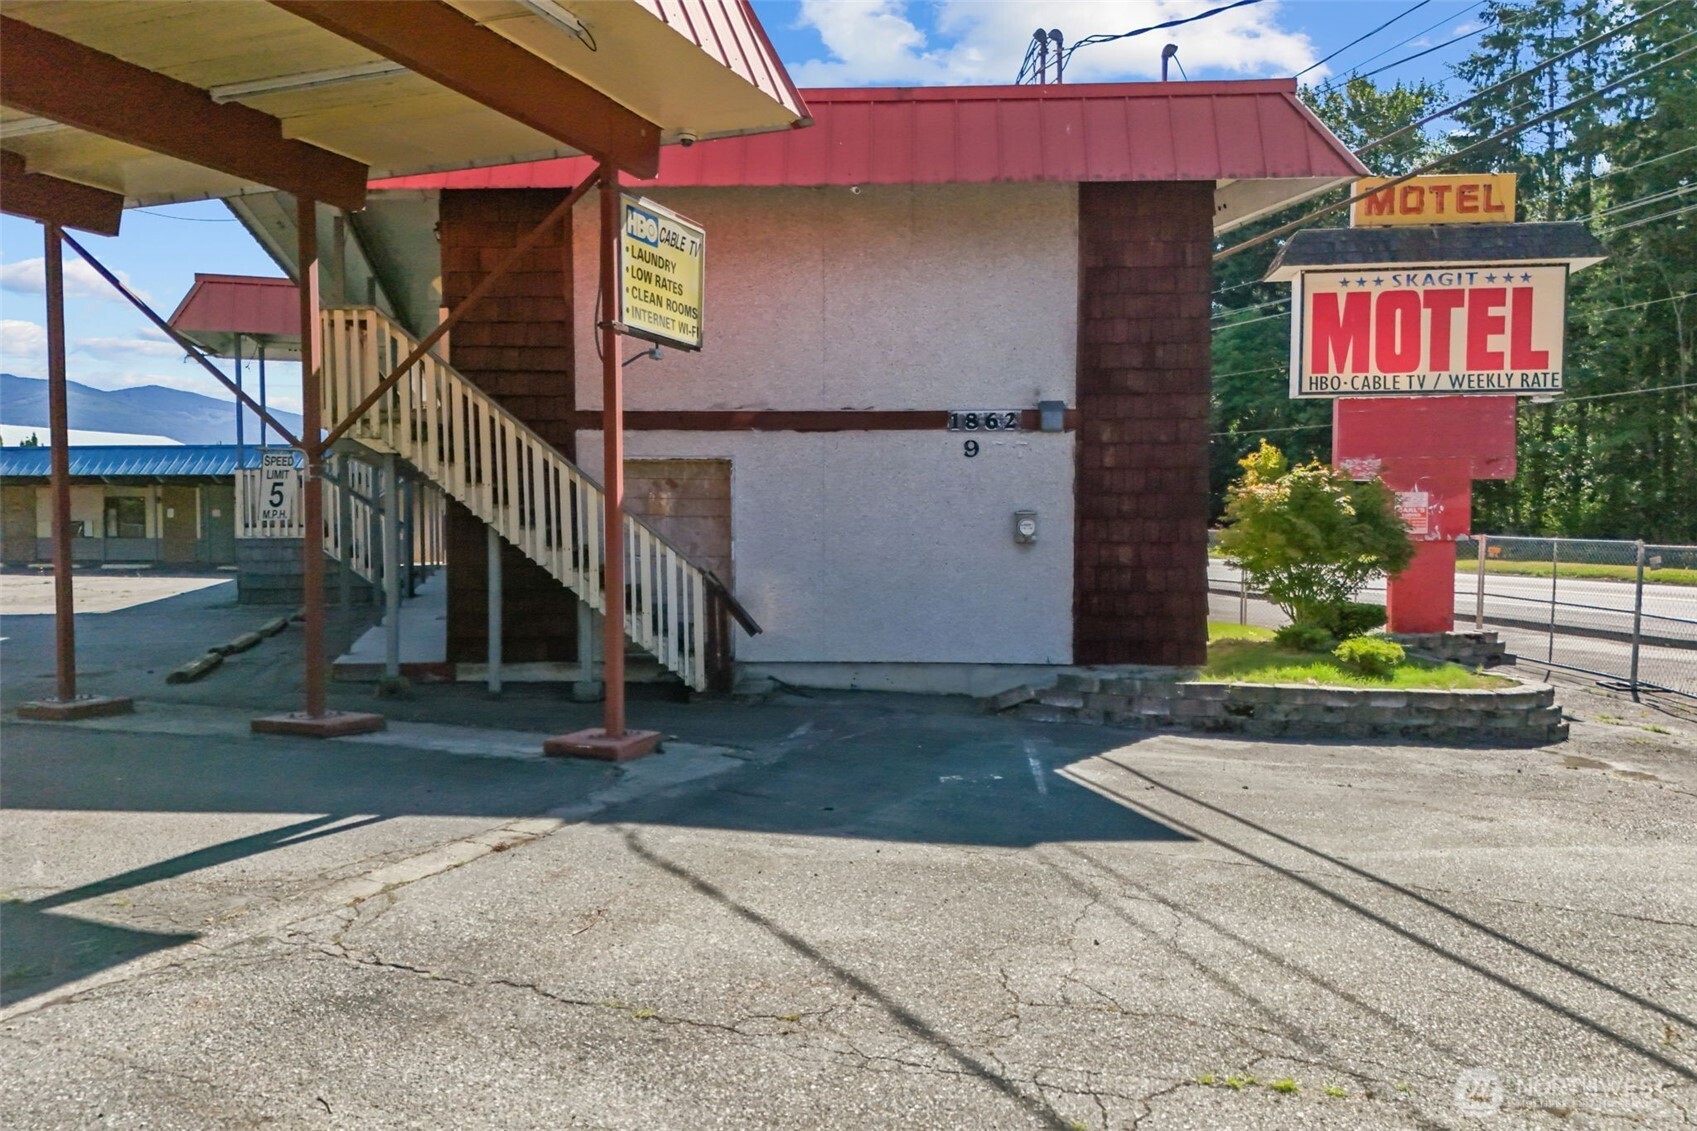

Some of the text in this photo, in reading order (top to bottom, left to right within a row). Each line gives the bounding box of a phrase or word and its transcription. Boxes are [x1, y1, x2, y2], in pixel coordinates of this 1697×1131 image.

[1364, 183, 1505, 216] MOTEL
[627, 209, 701, 258] HBO CABLE TV
[631, 245, 676, 274] LAUNDRY
[631, 265, 684, 296] LOW RATES
[1392, 272, 1478, 288] SKAGIT
[631, 286, 698, 319] CLEAN ROOMS
[631, 305, 699, 338] INTERNET WI-FI
[1311, 287, 1549, 375] MOTEL
[1406, 374, 1426, 390] TV
[1449, 372, 1515, 389] WEEKLY
[1521, 371, 1560, 388] RATE
[950, 412, 1016, 430] 1862
[264, 455, 294, 467] SPEED
[963, 439, 980, 458] 9
[266, 469, 290, 480] LIMIT
[268, 481, 284, 508] 5
